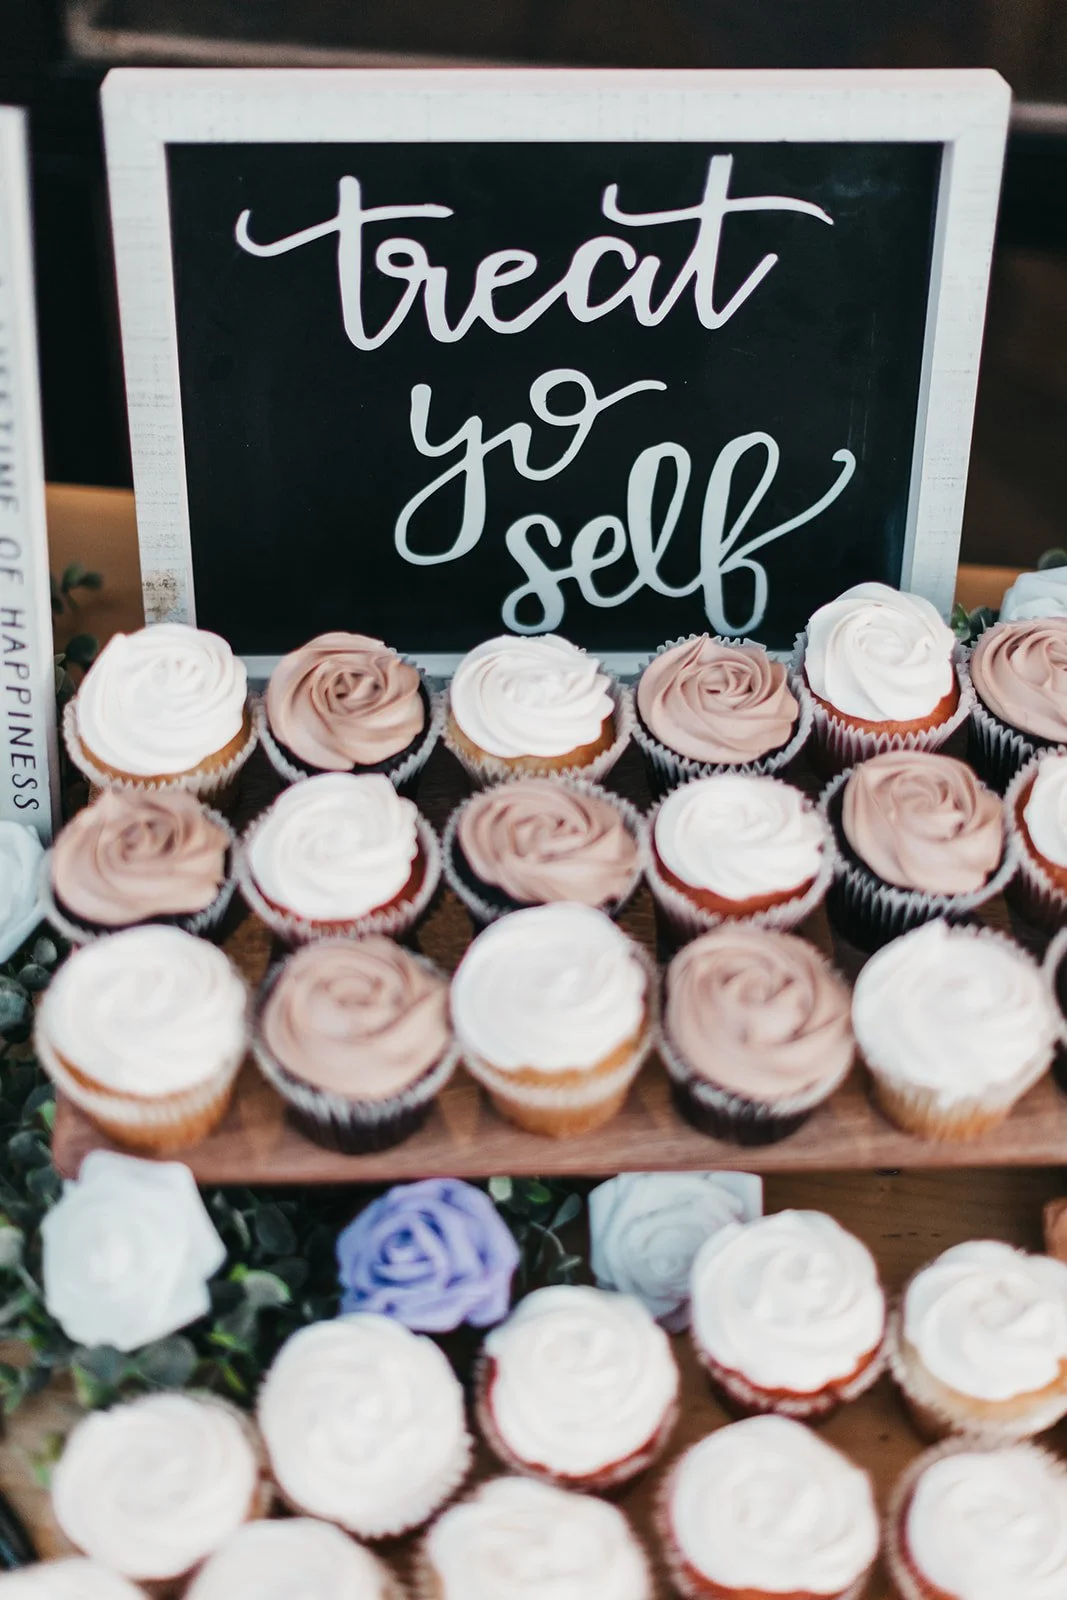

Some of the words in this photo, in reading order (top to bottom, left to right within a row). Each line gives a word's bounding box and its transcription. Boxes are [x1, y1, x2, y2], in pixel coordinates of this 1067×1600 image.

[235, 153, 834, 351] treat
[0, 537, 24, 585] OF
[394, 368, 668, 566] yo
[502, 431, 857, 636] self
[0, 607, 40, 809] HAPPINESS
